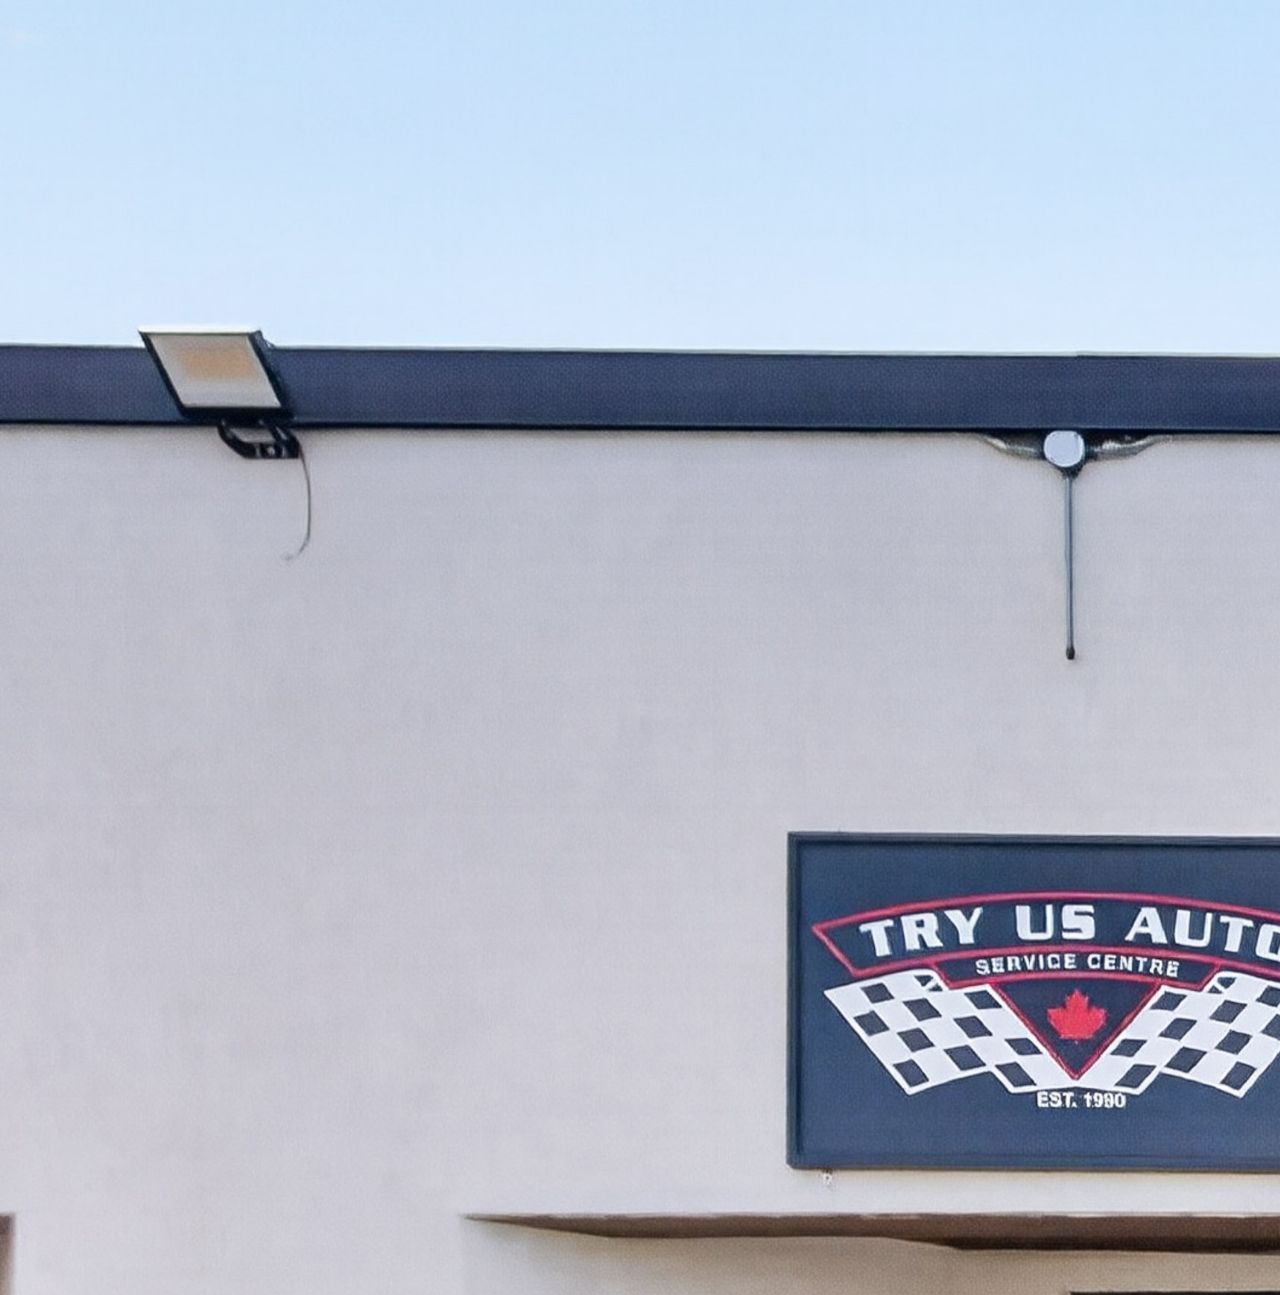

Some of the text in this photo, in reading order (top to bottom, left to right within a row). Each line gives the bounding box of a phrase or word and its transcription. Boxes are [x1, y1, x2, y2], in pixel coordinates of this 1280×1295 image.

[860, 906, 984, 957] TRY
[1016, 904, 1095, 941] US
[976, 953, 1180, 978] SERVICE CENTRE
[1037, 1092, 1126, 1109] EST. 1990
